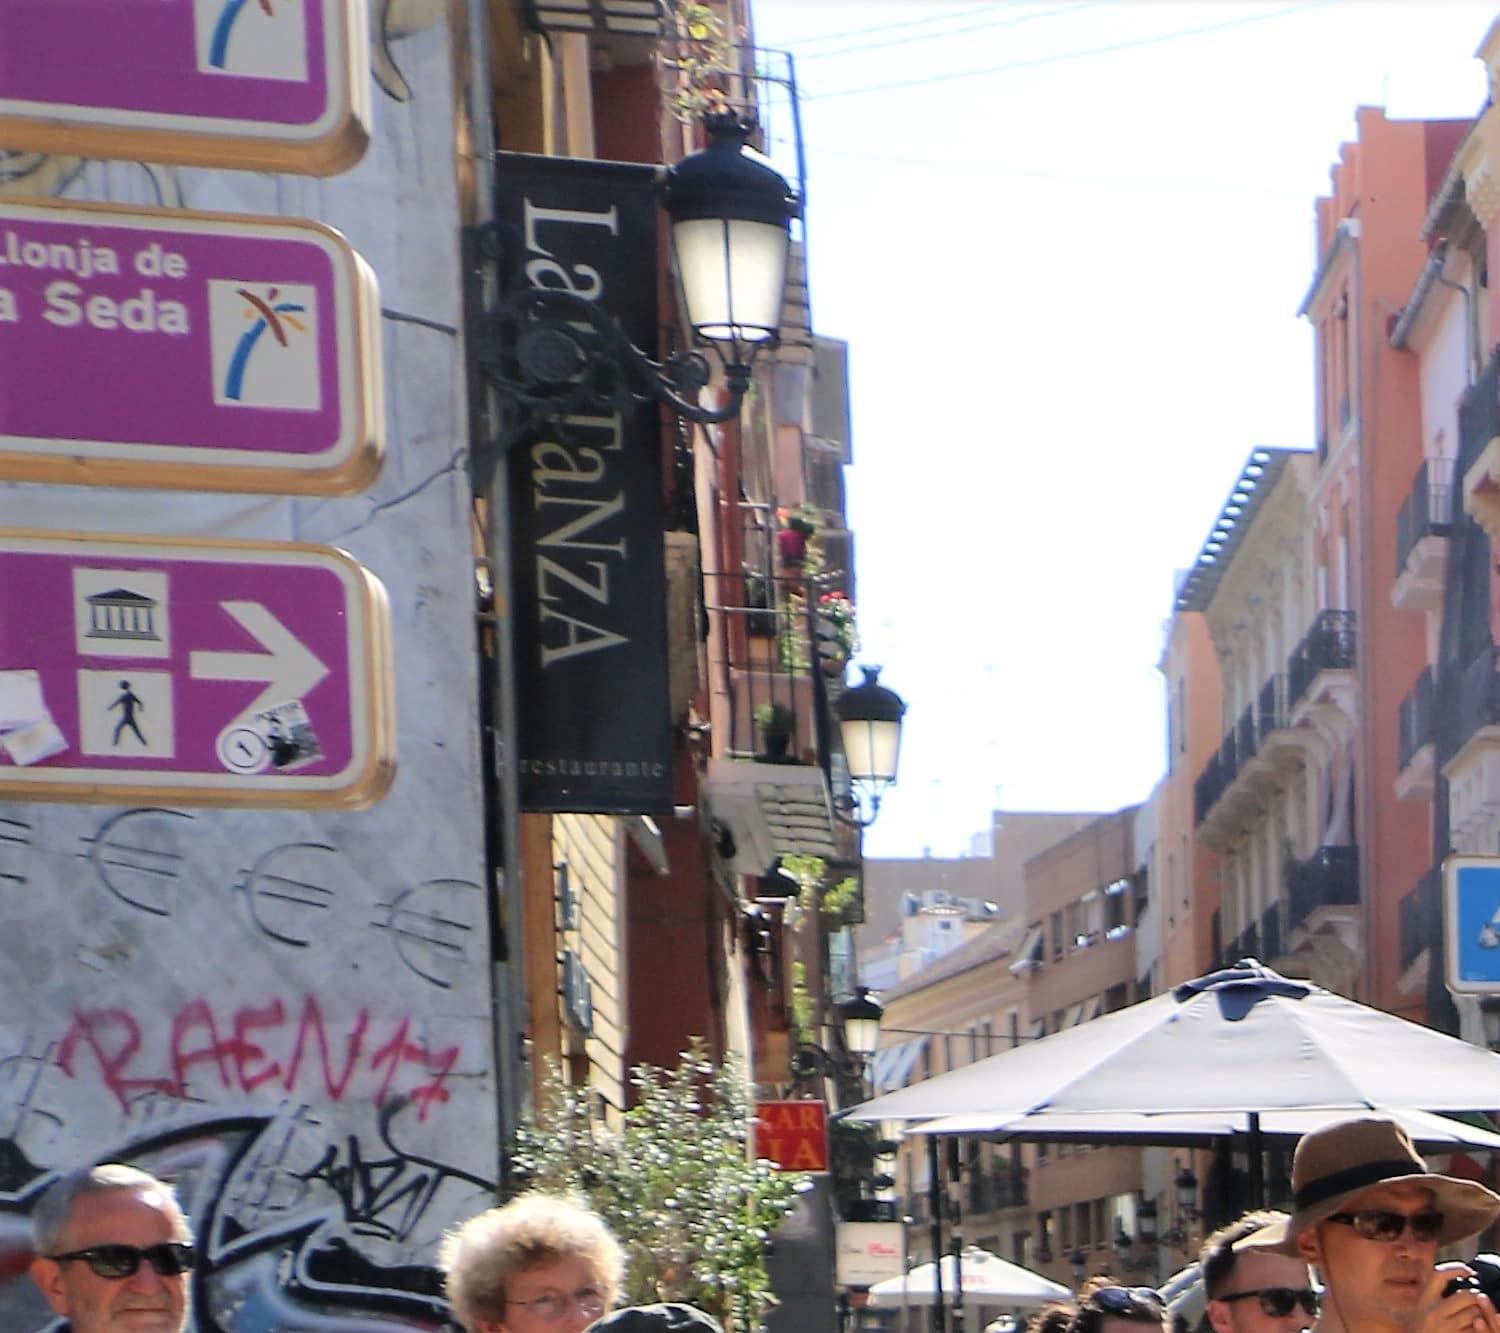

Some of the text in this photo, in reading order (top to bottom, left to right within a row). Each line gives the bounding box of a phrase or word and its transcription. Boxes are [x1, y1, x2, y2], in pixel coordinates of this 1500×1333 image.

[0, 231, 188, 279] lonja de
[524, 197, 620, 300] La
[42, 280, 190, 334] Seda
[519, 757, 664, 778] restaurante
